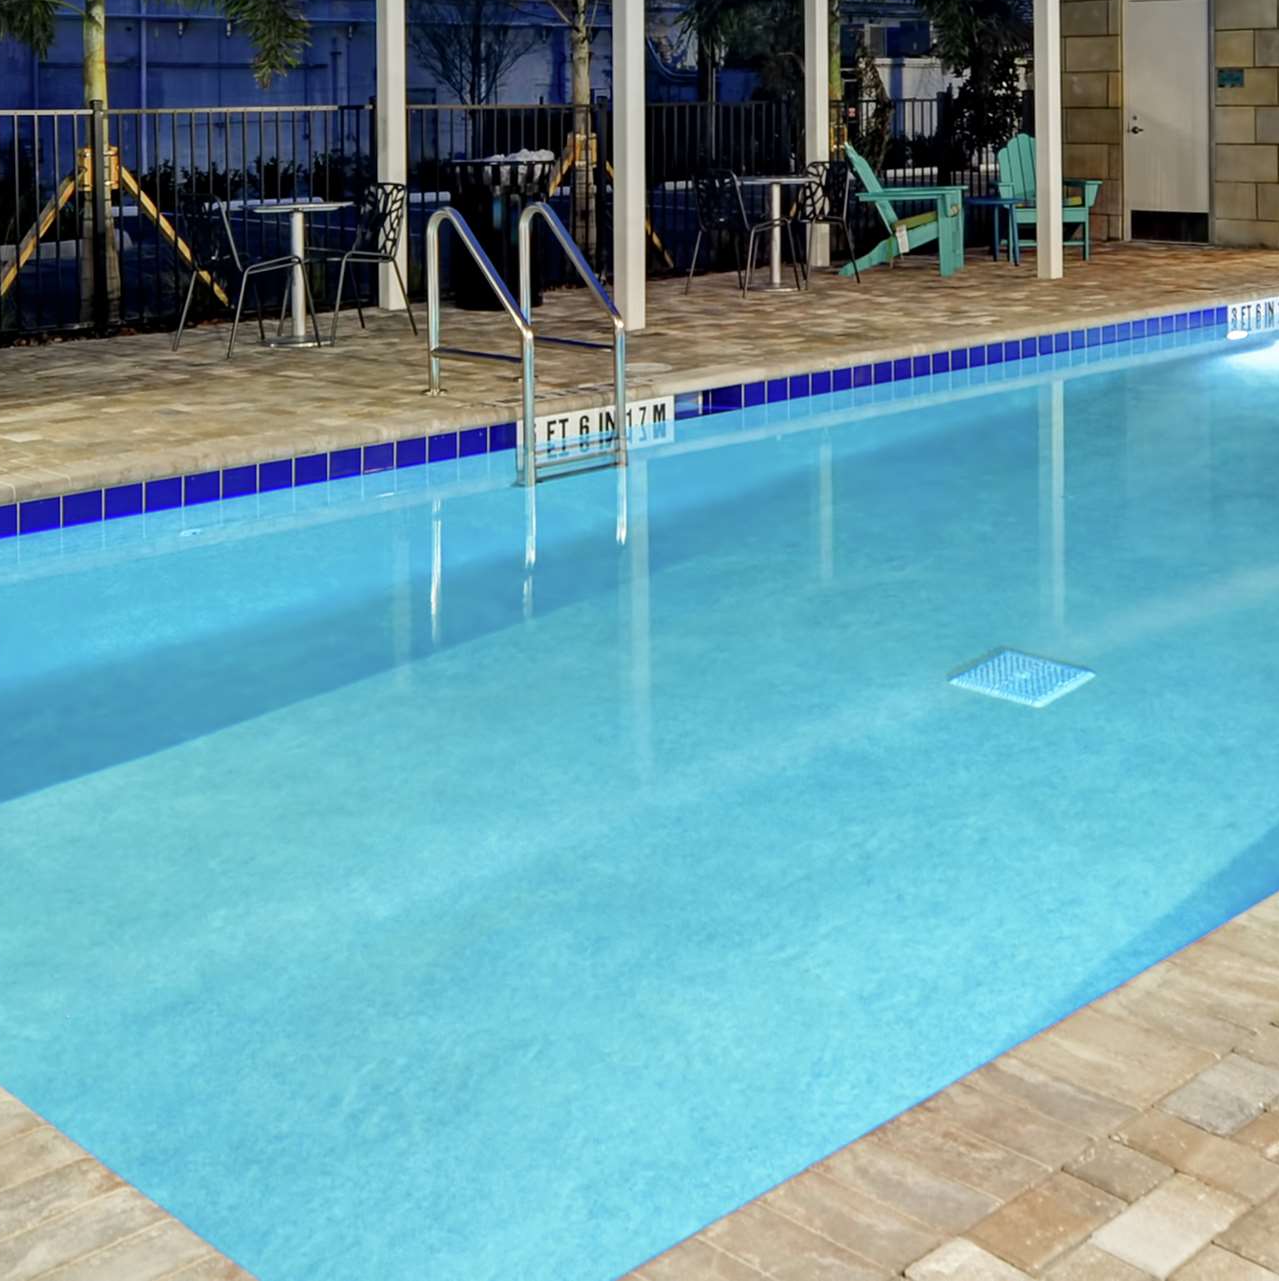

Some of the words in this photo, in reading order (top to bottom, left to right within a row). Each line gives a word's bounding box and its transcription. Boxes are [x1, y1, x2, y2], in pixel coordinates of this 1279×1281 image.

[547, 418, 569, 441] FT
[579, 415, 590, 436] 6
[652, 403, 666, 423] M
